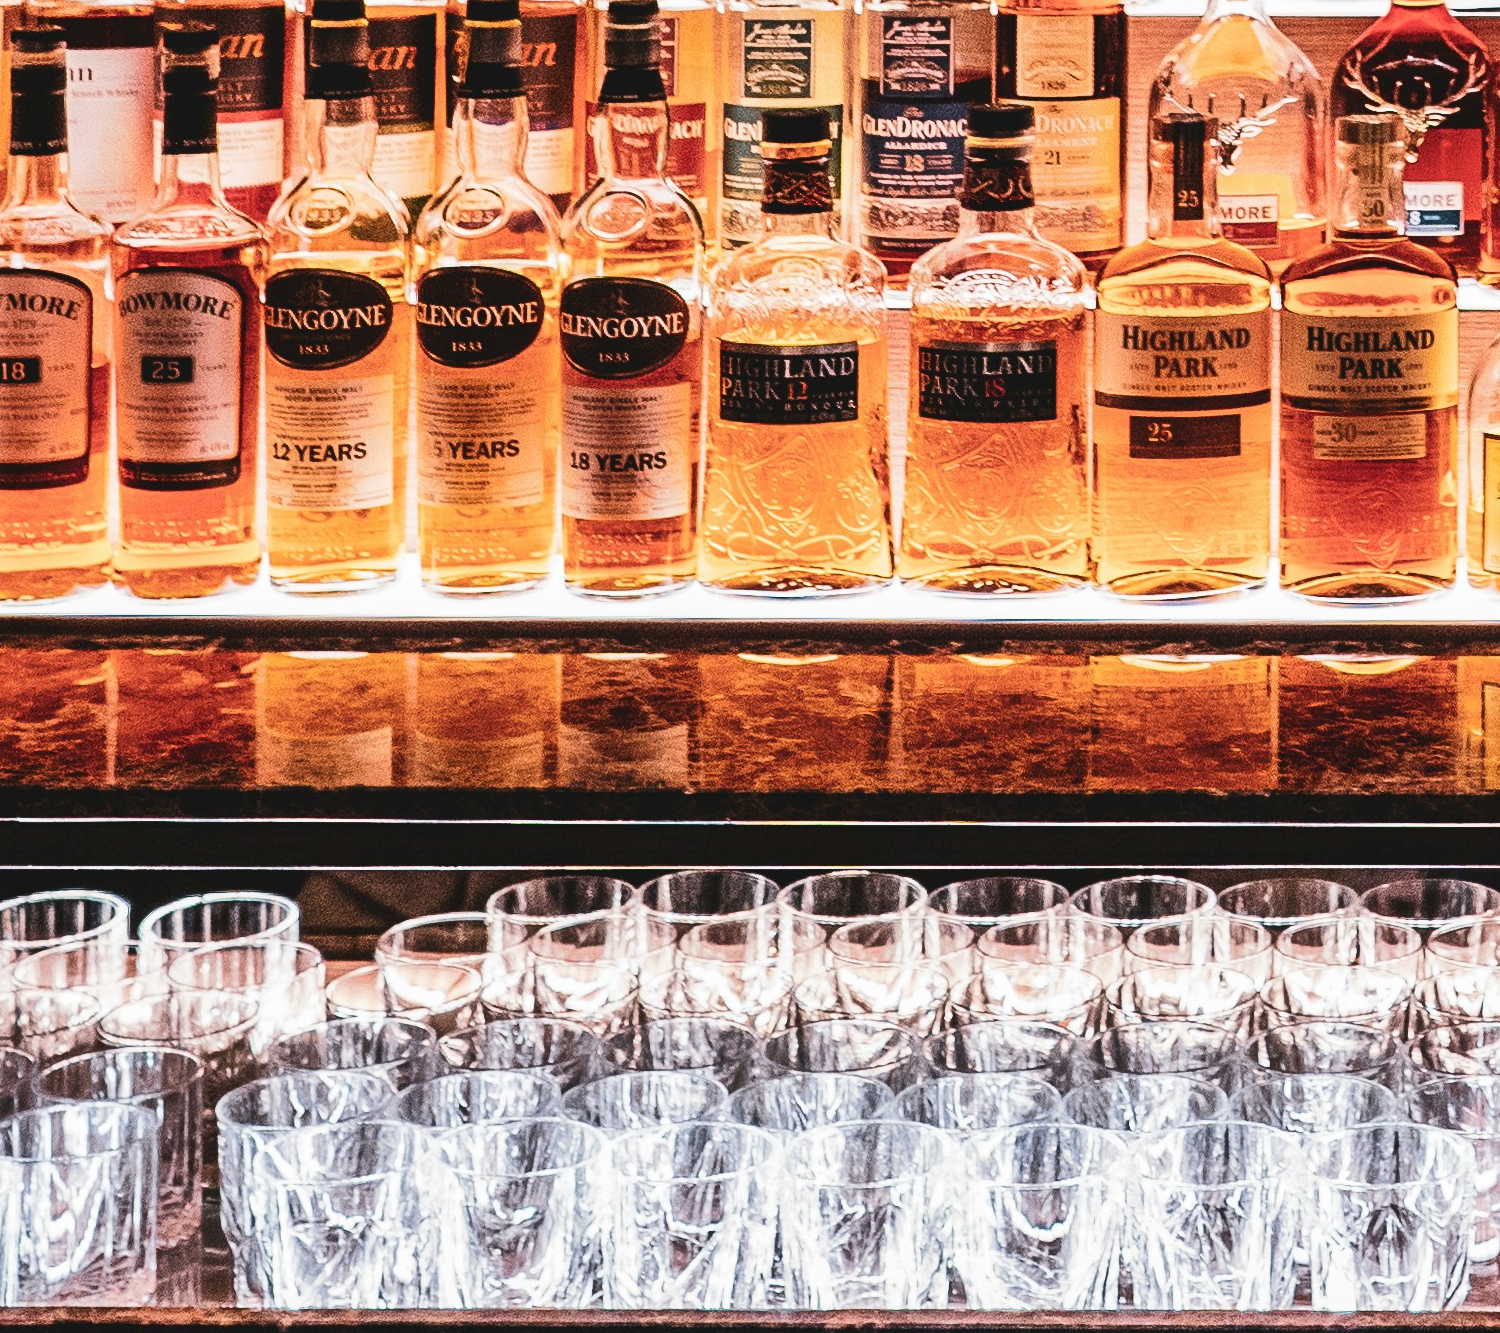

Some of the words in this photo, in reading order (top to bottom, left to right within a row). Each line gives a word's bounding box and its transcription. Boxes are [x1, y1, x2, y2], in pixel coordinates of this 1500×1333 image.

[863, 114, 968, 140] GLENDRONAC
[1035, 113, 1115, 135] DRONACH
[1177, 189, 1199, 207] 25
[1405, 193, 1458, 207] MORE
[1221, 204, 1274, 220] MORE
[1410, 210, 1421, 226] 8
[119, 291, 235, 321] BOWMORE
[265, 303, 386, 331] GLENGOYNE
[416, 300, 539, 328] GLENGOYNE
[561, 311, 685, 339] GLENGOYNE
[450, 340, 483, 353] 1833
[1122, 324, 1251, 352] HIGHLAND
[1306, 325, 1435, 352] HIGHLAND
[299, 343, 330, 356] 1833
[598, 351, 631, 364] 1833
[0, 361, 26, 380] 18
[151, 361, 180, 380] 25
[720, 352, 856, 380] HIGHLAND
[919, 352, 1054, 378] HIGHLAND
[1153, 355, 1219, 379] PARK
[1337, 355, 1403, 380] PARK
[721, 378, 781, 402] PARK
[786, 379, 809, 400] 12
[919, 375, 980, 401] PARK
[985, 379, 1006, 399] 18
[1147, 422, 1172, 443] 25
[272, 442, 291, 462] 12
[295, 441, 368, 462] YEARS
[447, 439, 521, 461] YEARS
[570, 452, 590, 471] 18
[595, 451, 668, 472] YEARS
